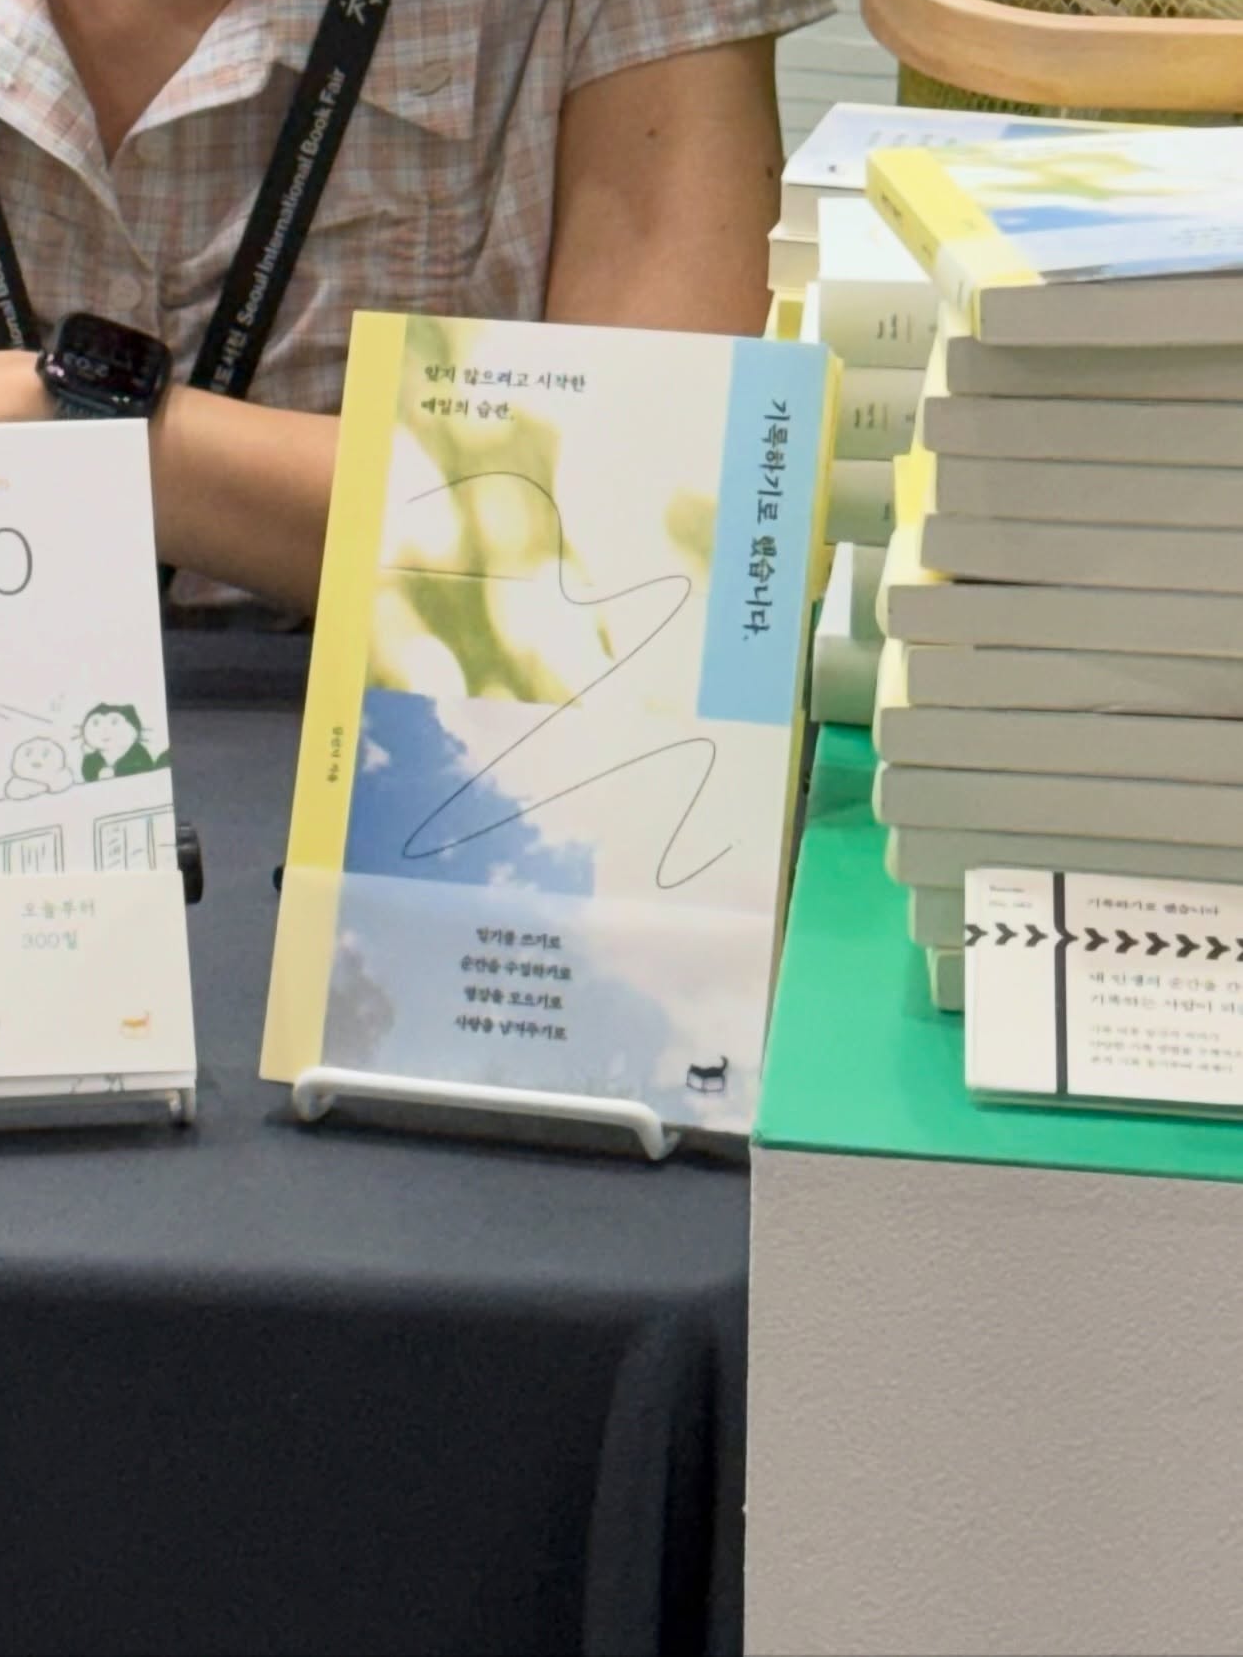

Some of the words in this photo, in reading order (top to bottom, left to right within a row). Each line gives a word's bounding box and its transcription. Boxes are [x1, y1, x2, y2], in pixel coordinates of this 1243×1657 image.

[236, 271, 270, 327] Seoul
[256, 154, 315, 274] International
[300, 108, 334, 156] Book
[319, 66, 347, 106] Fair
[463, 366, 530, 387] 않으려고
[757, 399, 791, 525] 기록하기로
[743, 535, 778, 642] 했습니다.
[20, 897, 97, 921] 오늘부터
[21, 930, 79, 952] 300일
